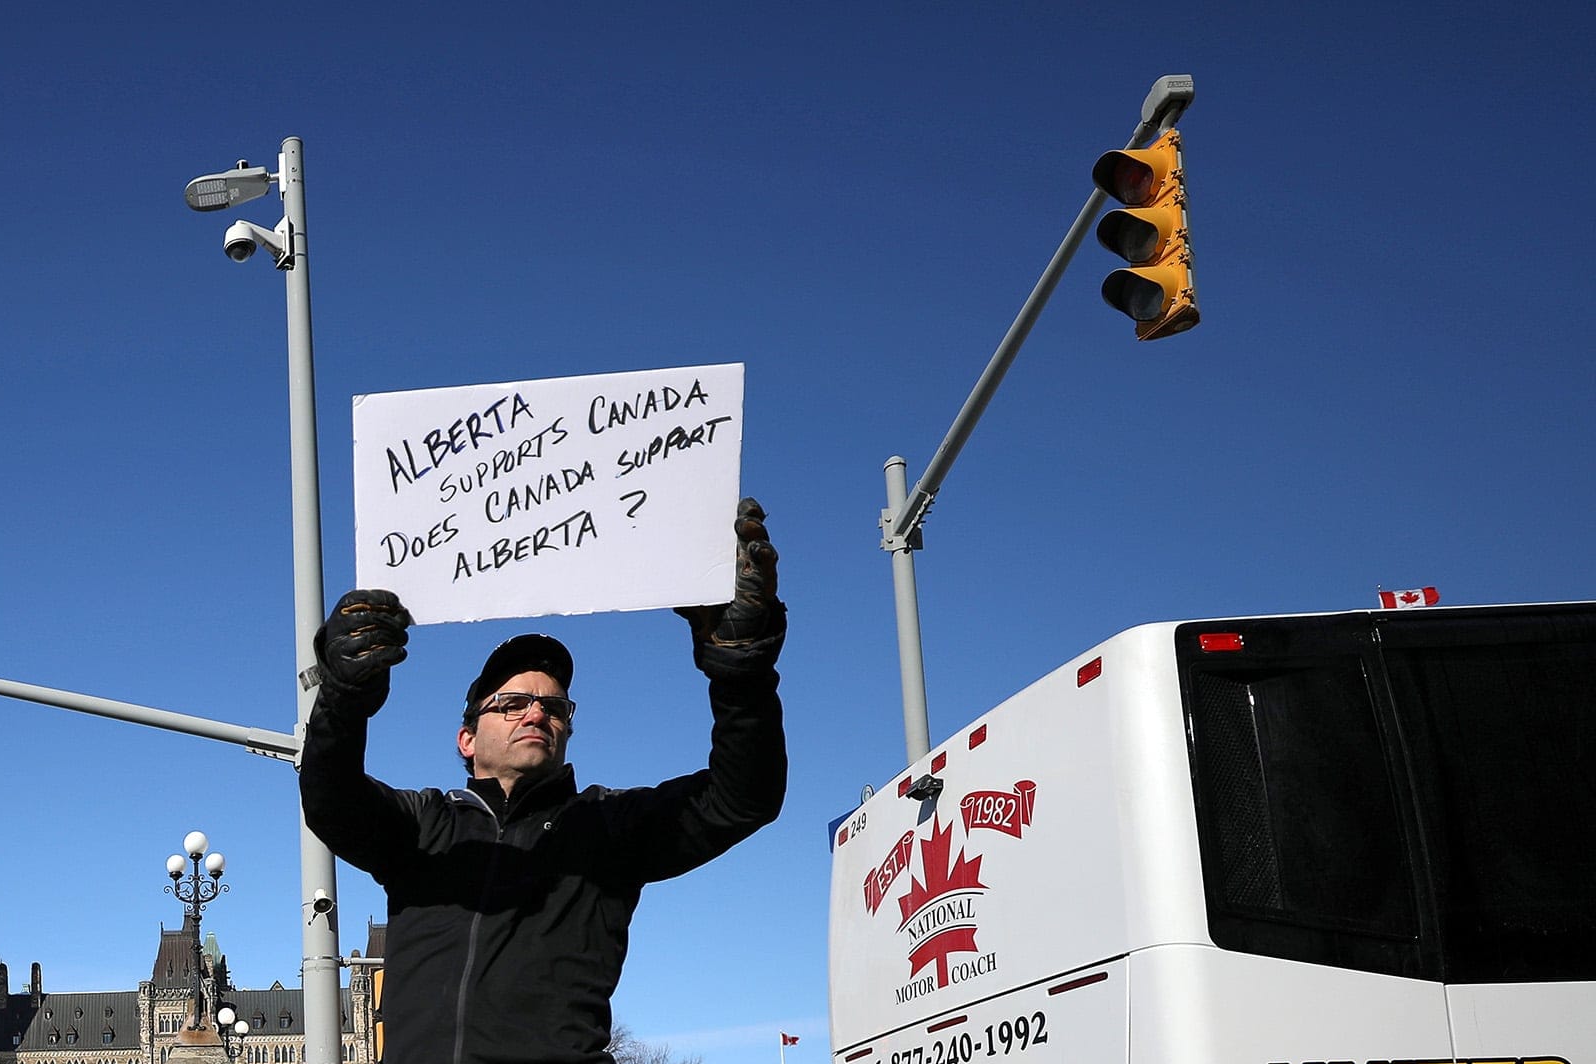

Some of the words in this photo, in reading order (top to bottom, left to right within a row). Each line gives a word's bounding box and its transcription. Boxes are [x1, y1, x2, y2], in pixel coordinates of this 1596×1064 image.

[386, 393, 535, 493] ALBERTA
[440, 416, 569, 503] SUPPORTS
[588, 378, 709, 434] CANADA
[380, 513, 459, 567] DOES
[485, 460, 595, 524] CANADA
[615, 415, 733, 478] SUPPORT
[452, 510, 598, 583] ALBERTA
[619, 489, 648, 529] ?
[850, 812, 867, 839] 249
[973, 796, 1017, 829] 1982
[877, 849, 905, 892] EST.
[908, 898, 976, 945] NATIONAL
[895, 976, 935, 1005] MOTOR
[951, 952, 997, 984] COACH
